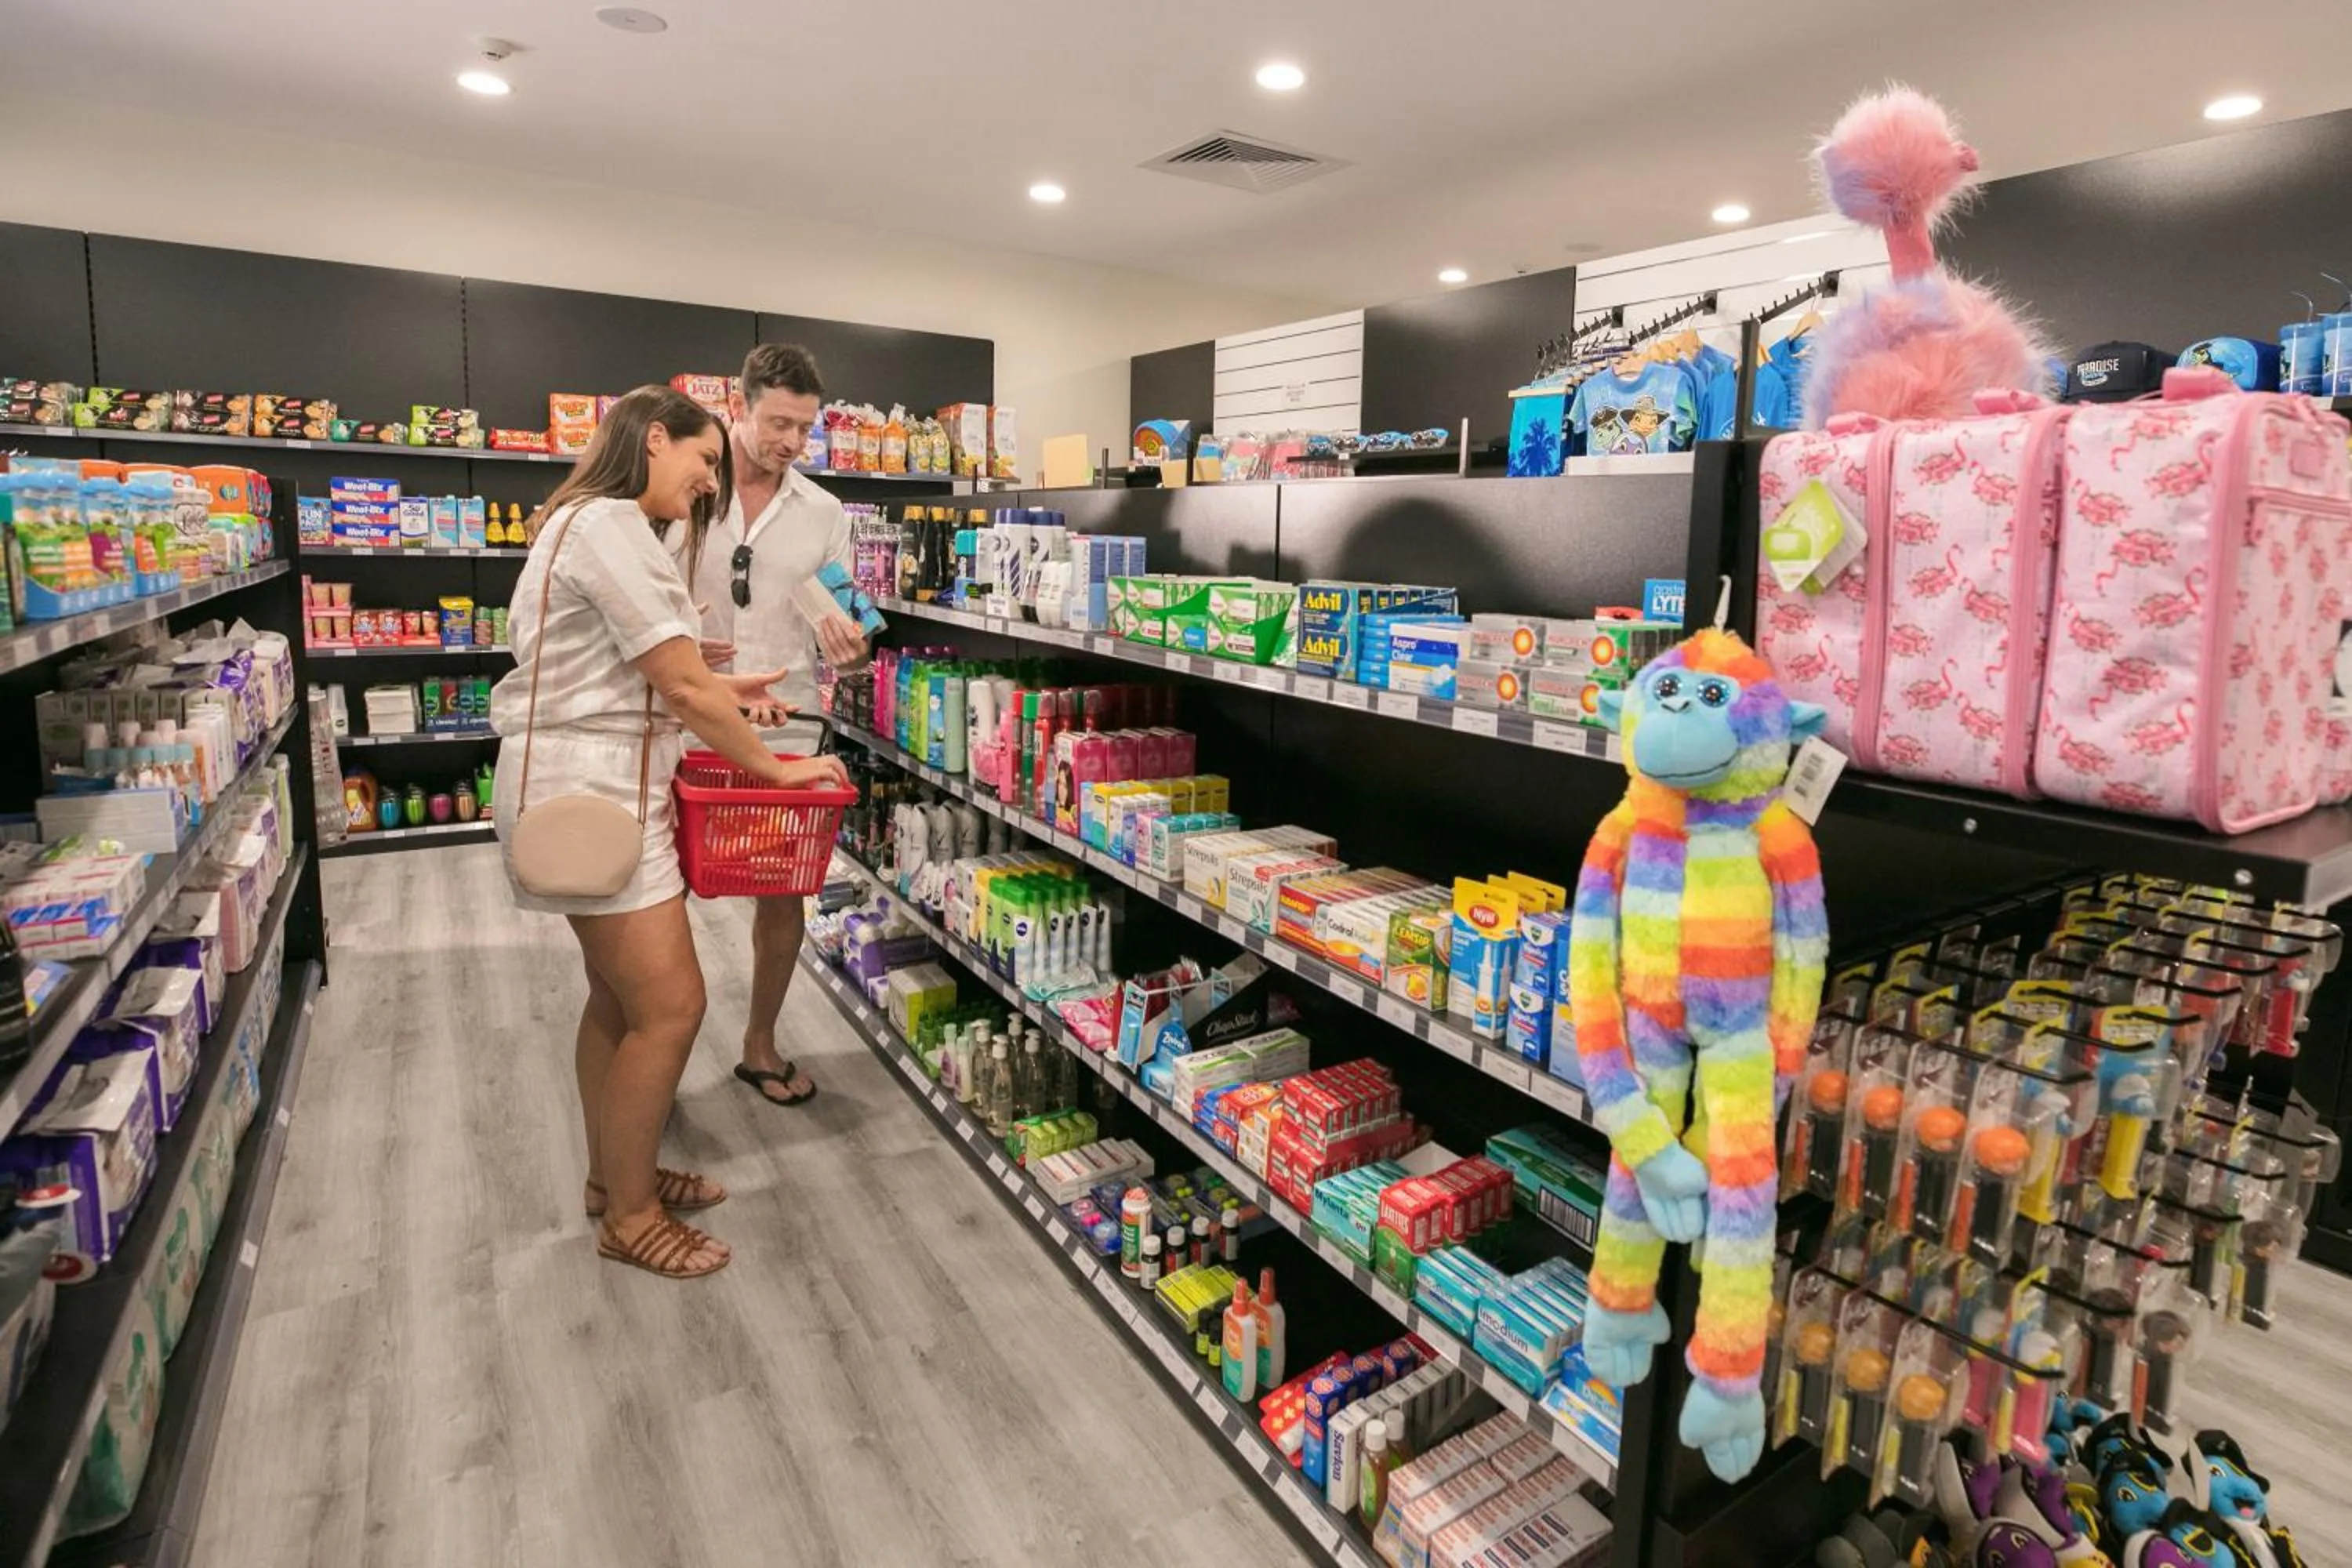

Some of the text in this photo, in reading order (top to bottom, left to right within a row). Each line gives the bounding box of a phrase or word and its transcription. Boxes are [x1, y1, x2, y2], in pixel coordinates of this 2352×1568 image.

[344, 481, 384, 492] Weet-Bix
[346, 504, 386, 515] Weet-Bix
[347, 527, 386, 538] Weet-Bix
[1304, 590, 1341, 611] Advil
[1302, 635, 1339, 658] Advil
[1229, 867, 1268, 894] Strepsils
[1328, 918, 1355, 938] Codral
[1315, 1188, 1348, 1219] Mylanta
[1479, 1305, 1529, 1352] Imodium
[1333, 1429, 1345, 1482] Savlon
